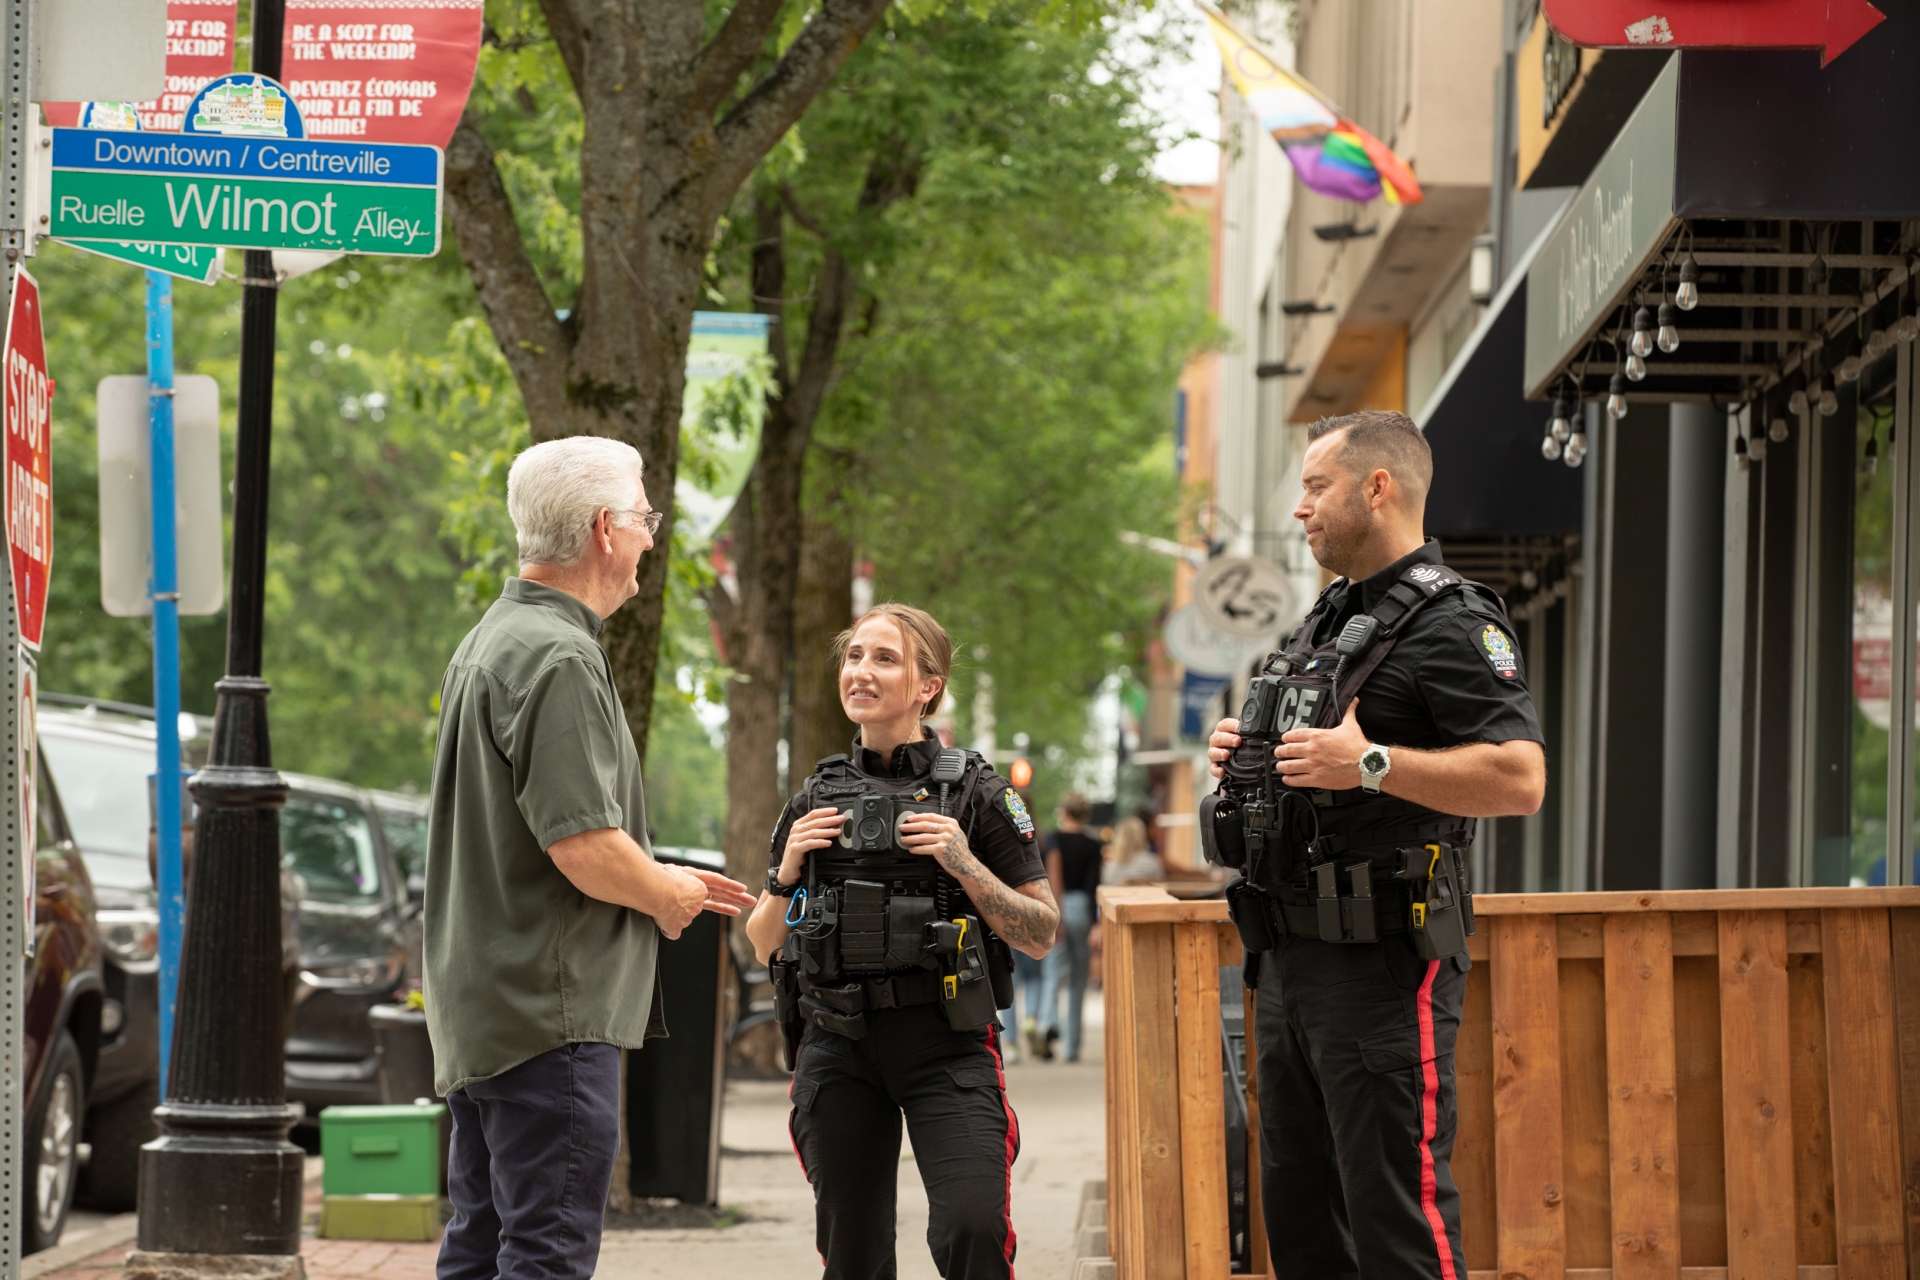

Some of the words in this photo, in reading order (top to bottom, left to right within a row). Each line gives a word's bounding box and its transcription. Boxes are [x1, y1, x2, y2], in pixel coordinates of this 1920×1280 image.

[191, 20, 227, 38] FOR
[292, 24, 314, 41] BE
[318, 24, 332, 41] A
[336, 24, 377, 41] SCOT
[379, 24, 414, 41] FOR
[292, 43, 326, 60] THE
[330, 43, 416, 60] WEEKEND!
[289, 80, 361, 97] DEVENEZ
[365, 77, 437, 98] ÉCOSSAIS
[337, 99, 361, 116] LA
[365, 99, 394, 116] FIN
[398, 99, 423, 117] DE
[95, 138, 230, 168] Downtown
[239, 145, 250, 169] /
[258, 146, 391, 175] Centreville
[59, 195, 145, 226] Ruelle
[165, 181, 337, 236] Wilmot
[353, 209, 421, 246] Alley
[10, 347, 48, 454] STOP
[11, 456, 49, 565] ARRÊT
